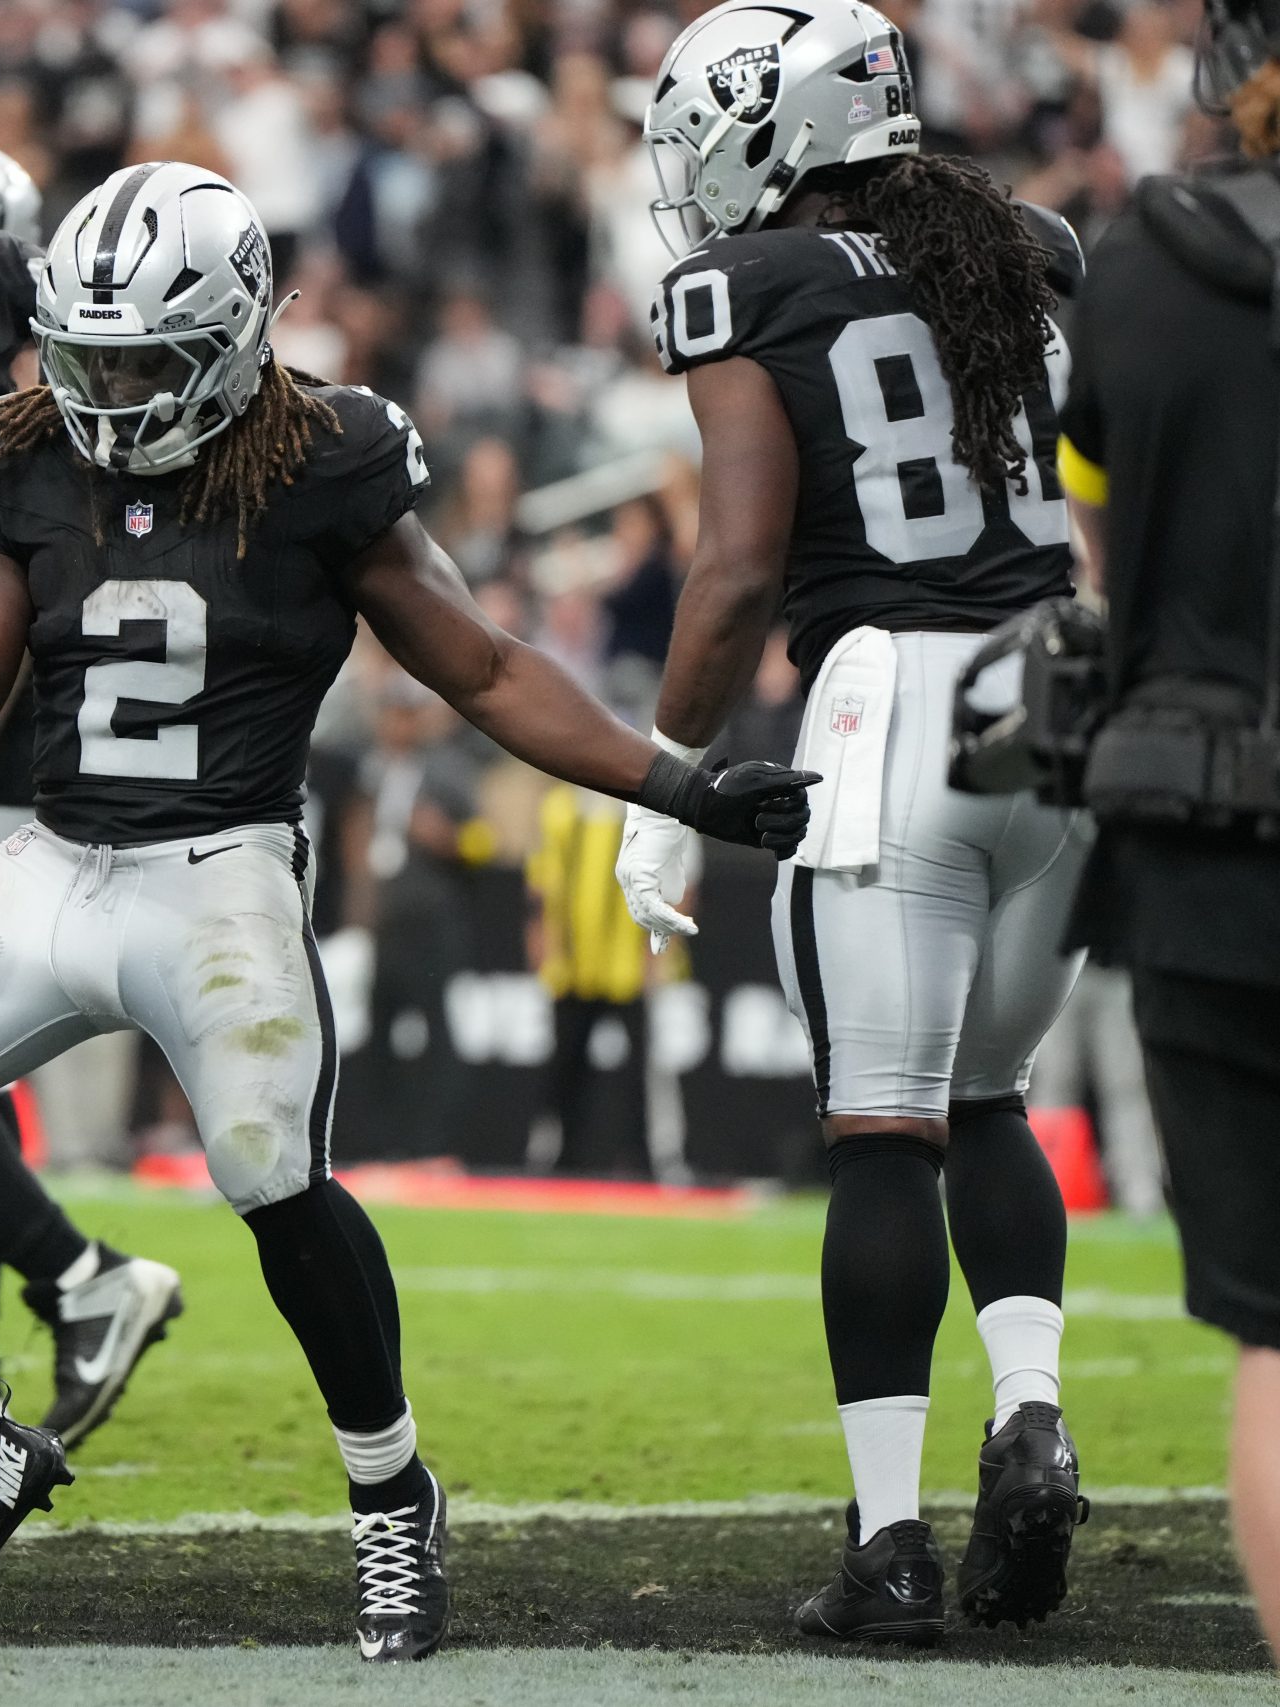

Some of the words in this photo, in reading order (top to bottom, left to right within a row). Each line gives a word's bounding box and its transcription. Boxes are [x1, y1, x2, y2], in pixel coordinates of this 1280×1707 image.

[712, 46, 773, 75] RAIDERS
[233, 225, 258, 264] RAIDERS
[79, 308, 123, 321] RAIDERS
[77, 579, 207, 781] 2
